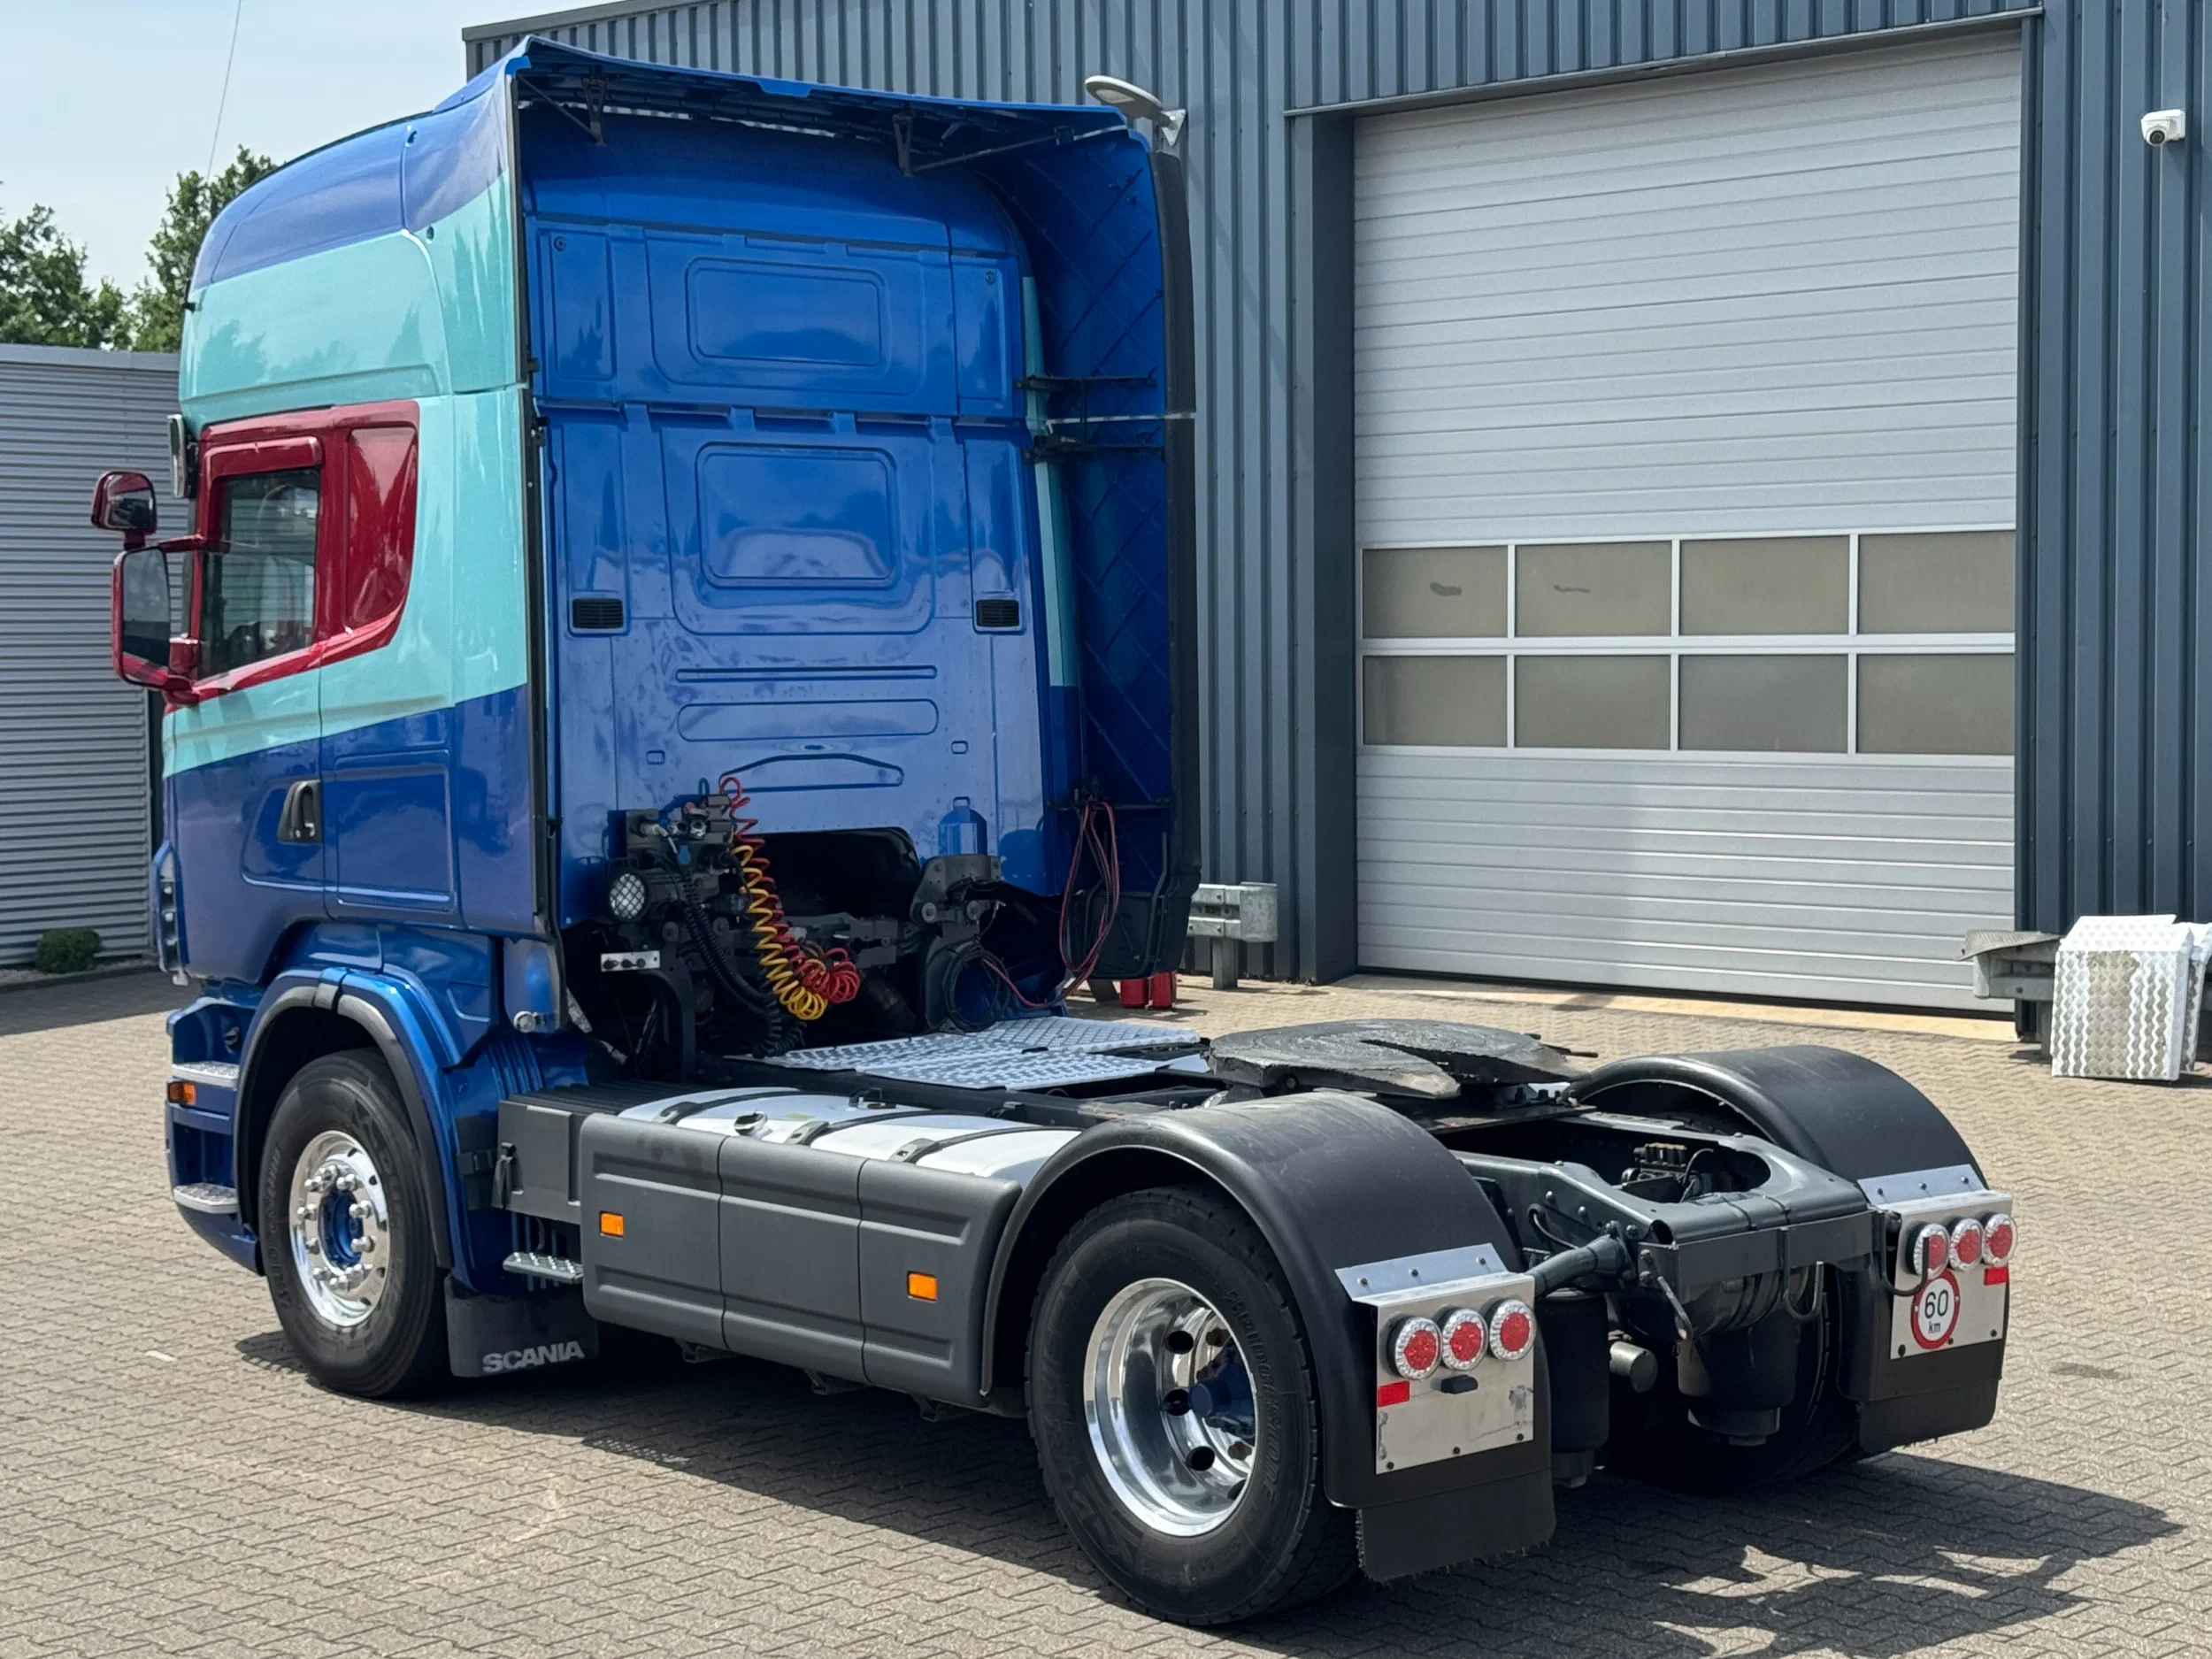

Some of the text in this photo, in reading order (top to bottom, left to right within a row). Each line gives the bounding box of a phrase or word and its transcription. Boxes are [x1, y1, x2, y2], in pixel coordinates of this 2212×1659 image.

[1924, 1289, 1949, 1319] 60
[1929, 1322, 1941, 1334] km
[483, 1341, 585, 1373] SCANIA
